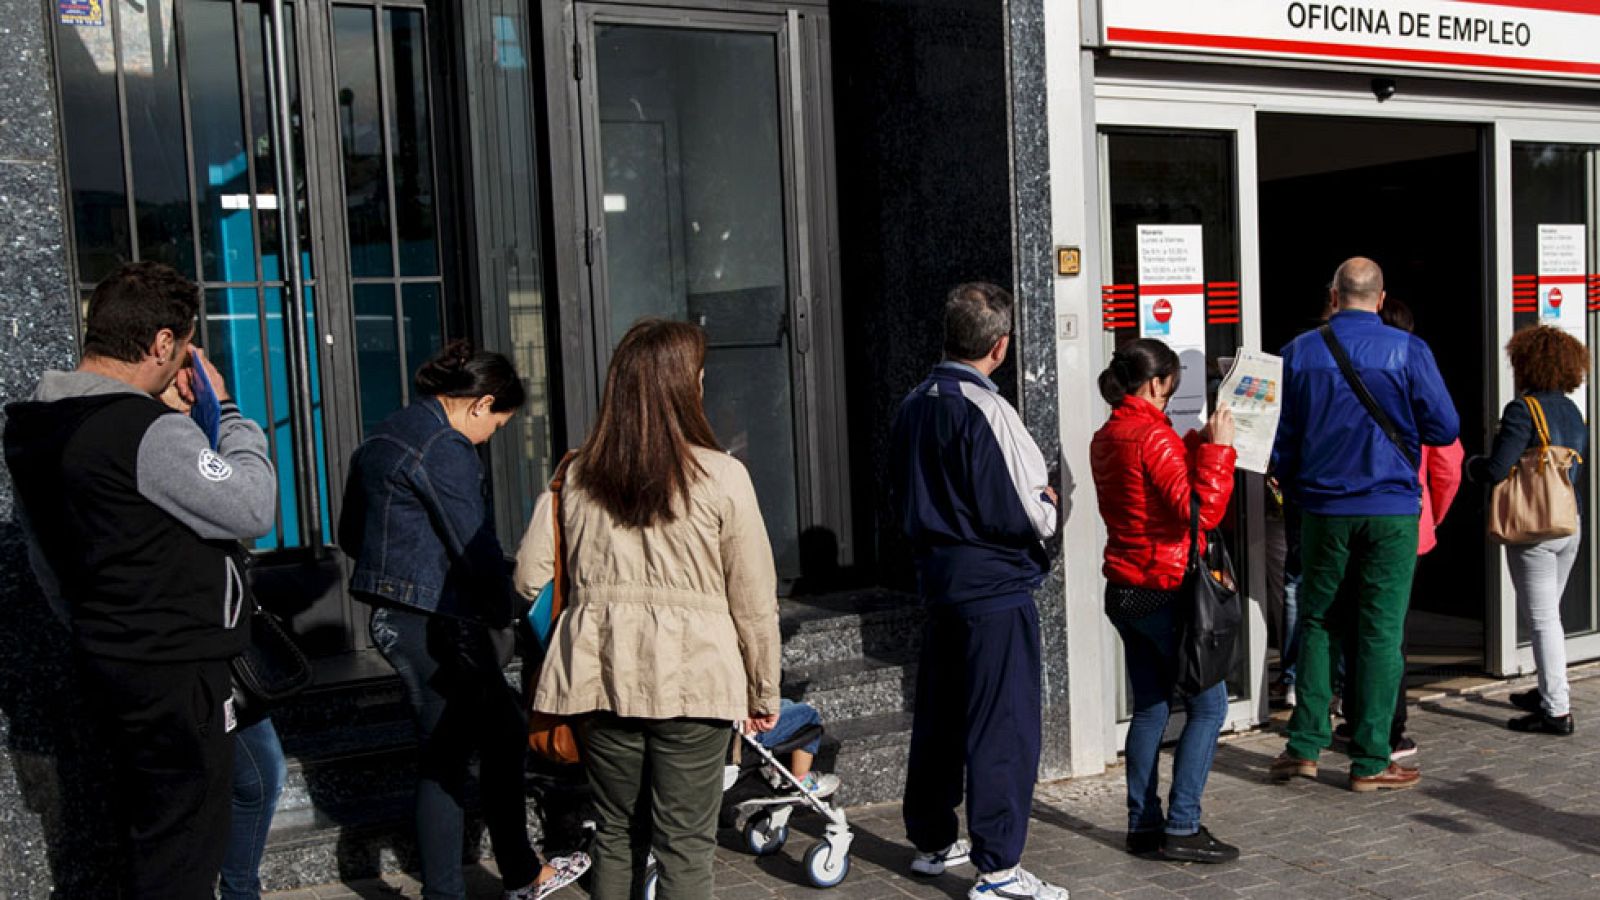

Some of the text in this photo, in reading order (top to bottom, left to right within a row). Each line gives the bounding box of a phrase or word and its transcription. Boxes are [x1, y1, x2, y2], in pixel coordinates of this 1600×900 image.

[1287, 2, 1531, 47] OFICINA DE EMPLEO
